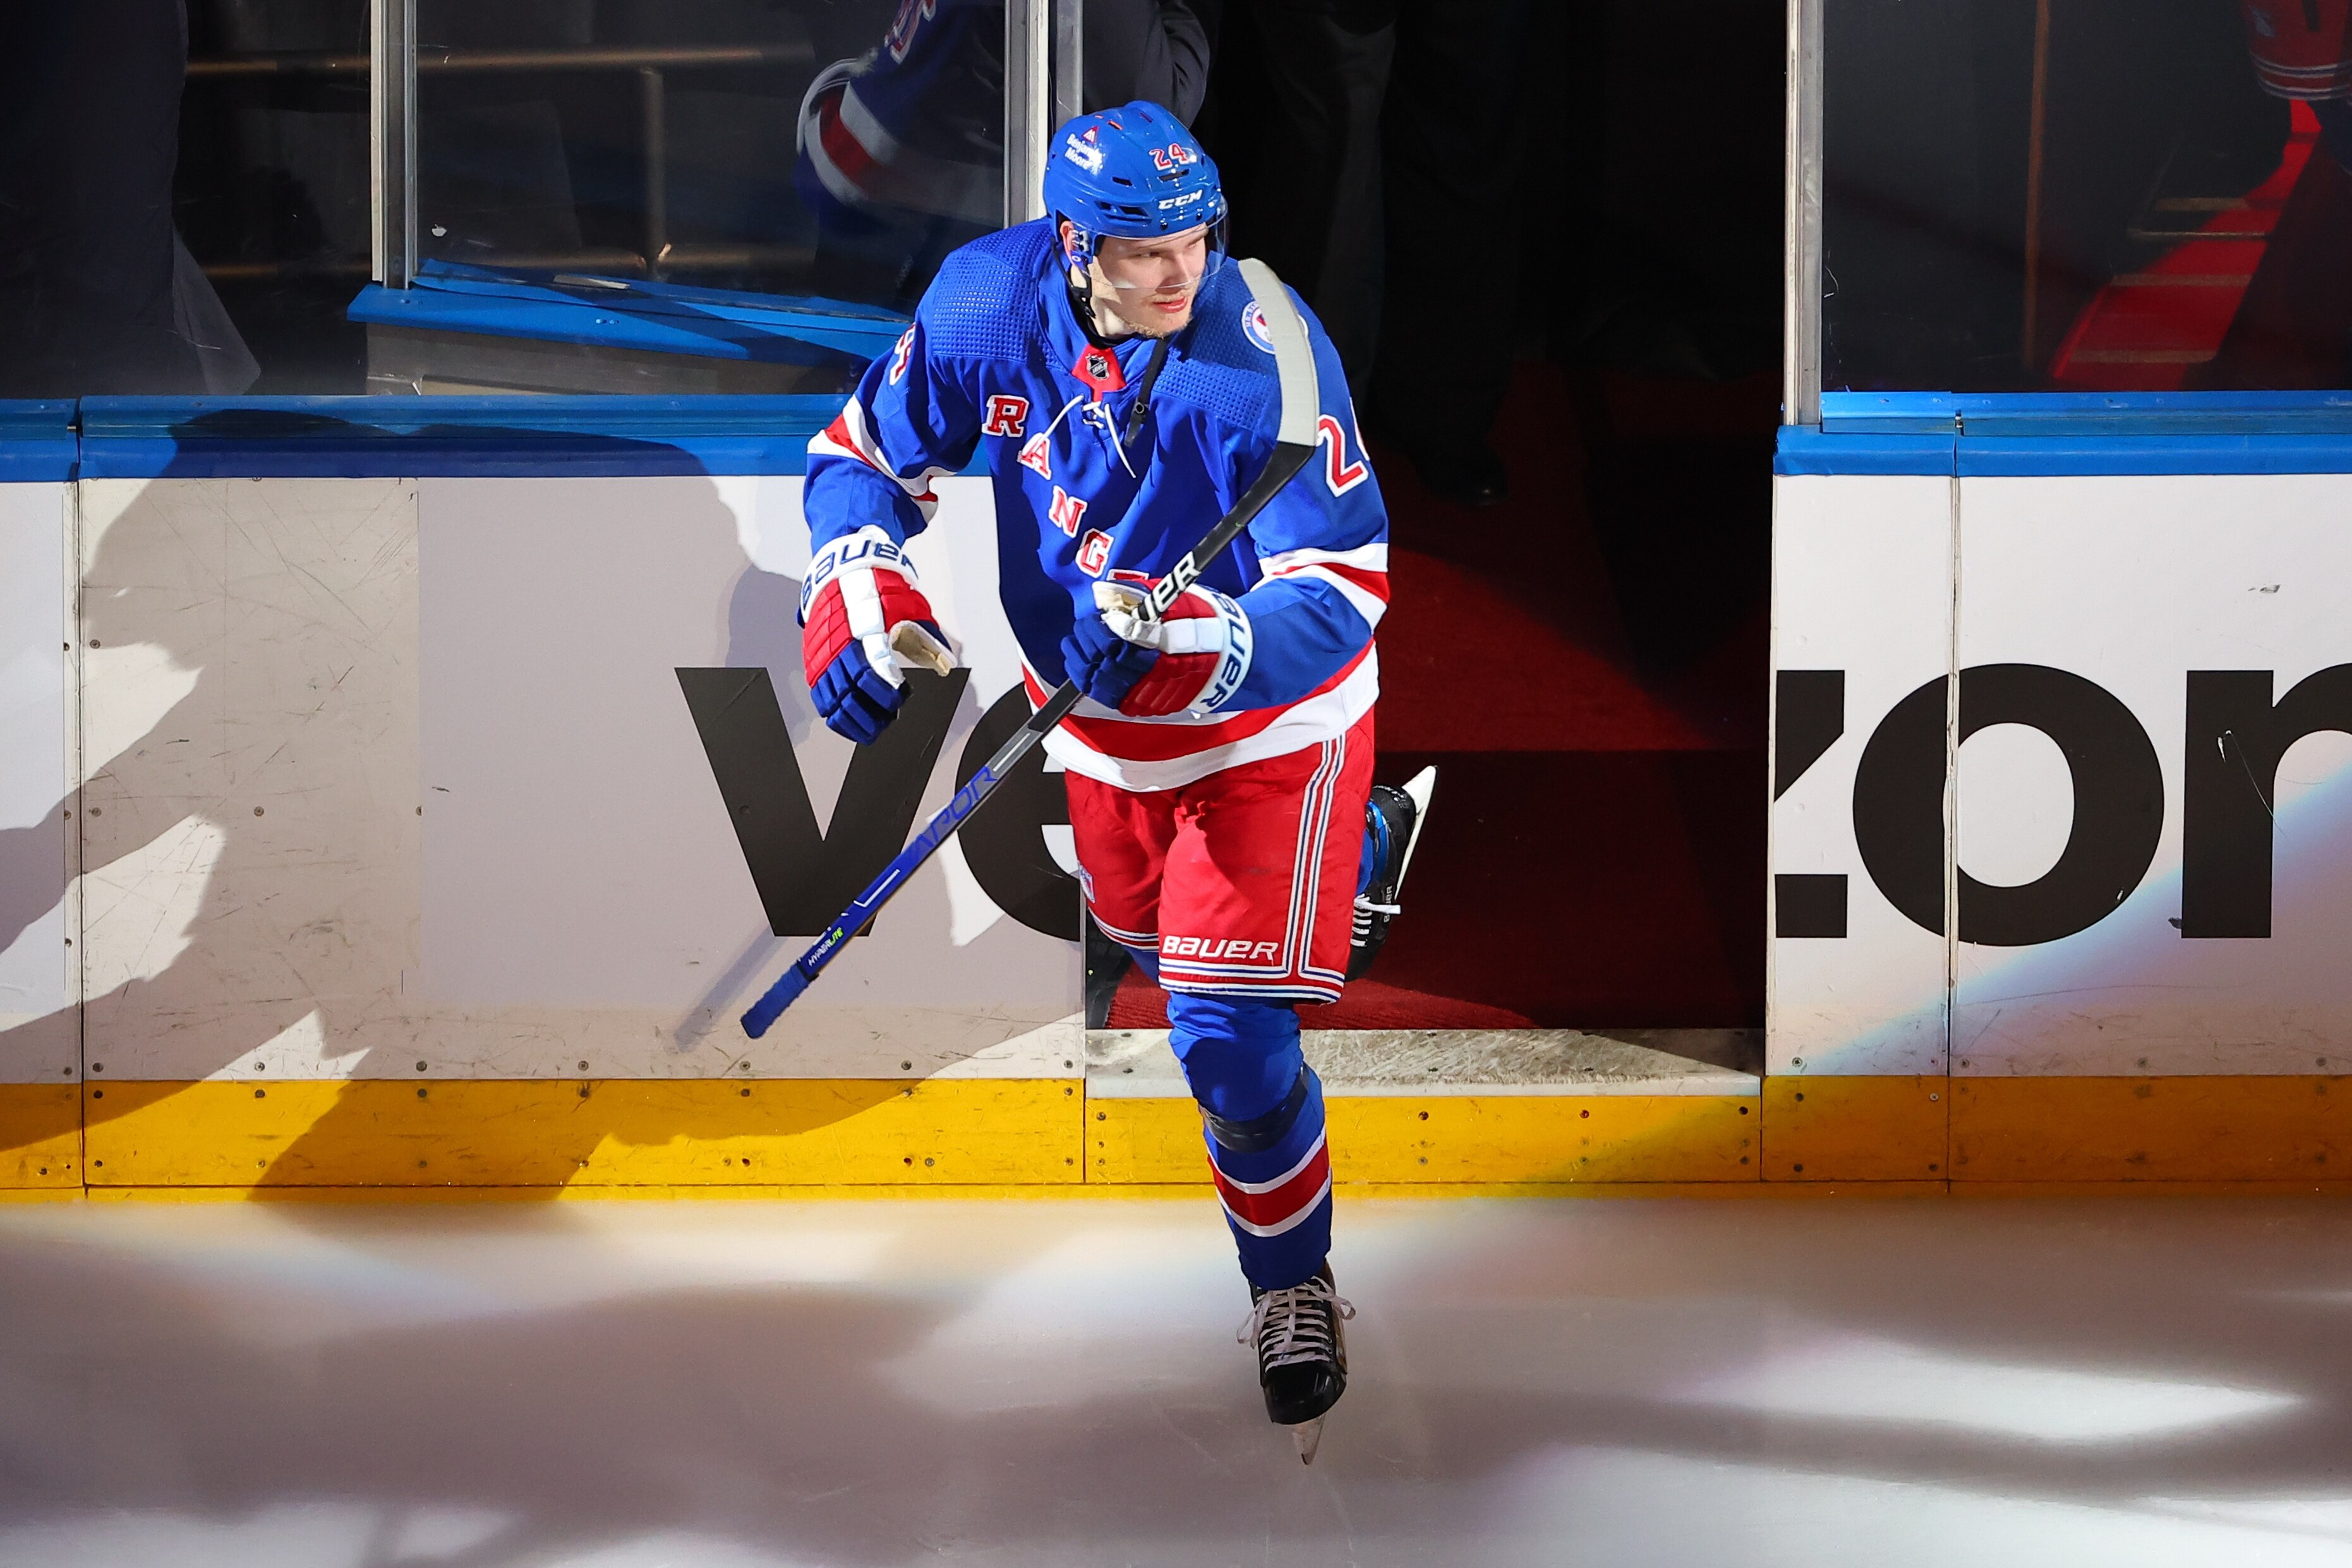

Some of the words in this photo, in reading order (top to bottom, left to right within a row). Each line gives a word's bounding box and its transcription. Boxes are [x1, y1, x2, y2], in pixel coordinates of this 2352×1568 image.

[1149, 143, 1191, 171] 24
[1158, 190, 1202, 210] CCM
[1316, 397, 1370, 497] 2
[982, 394, 1150, 581] RANG
[1196, 584, 1246, 708] AUER
[1162, 935, 1279, 962] BAUER
